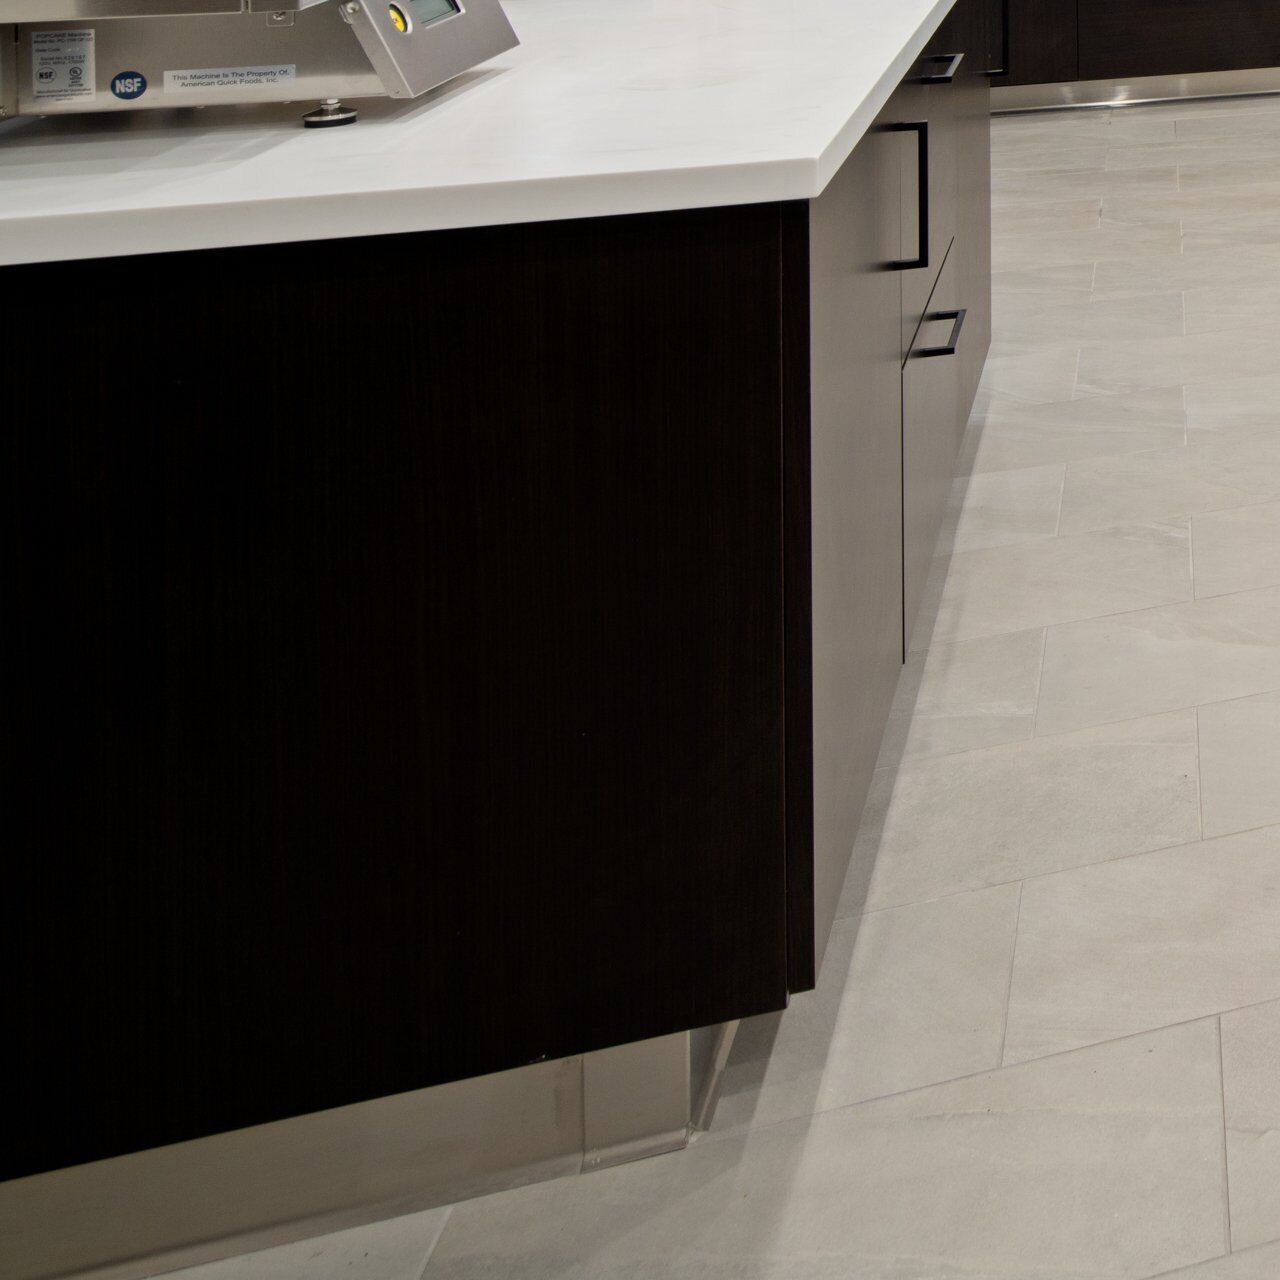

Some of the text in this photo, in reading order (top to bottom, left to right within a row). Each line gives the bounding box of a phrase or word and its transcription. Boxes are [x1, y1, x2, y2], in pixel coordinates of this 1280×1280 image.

[39, 71, 54, 80] NSF
[190, 72, 221, 80] Machine
[247, 69, 277, 78] Property
[115, 77, 142, 94] NSF
